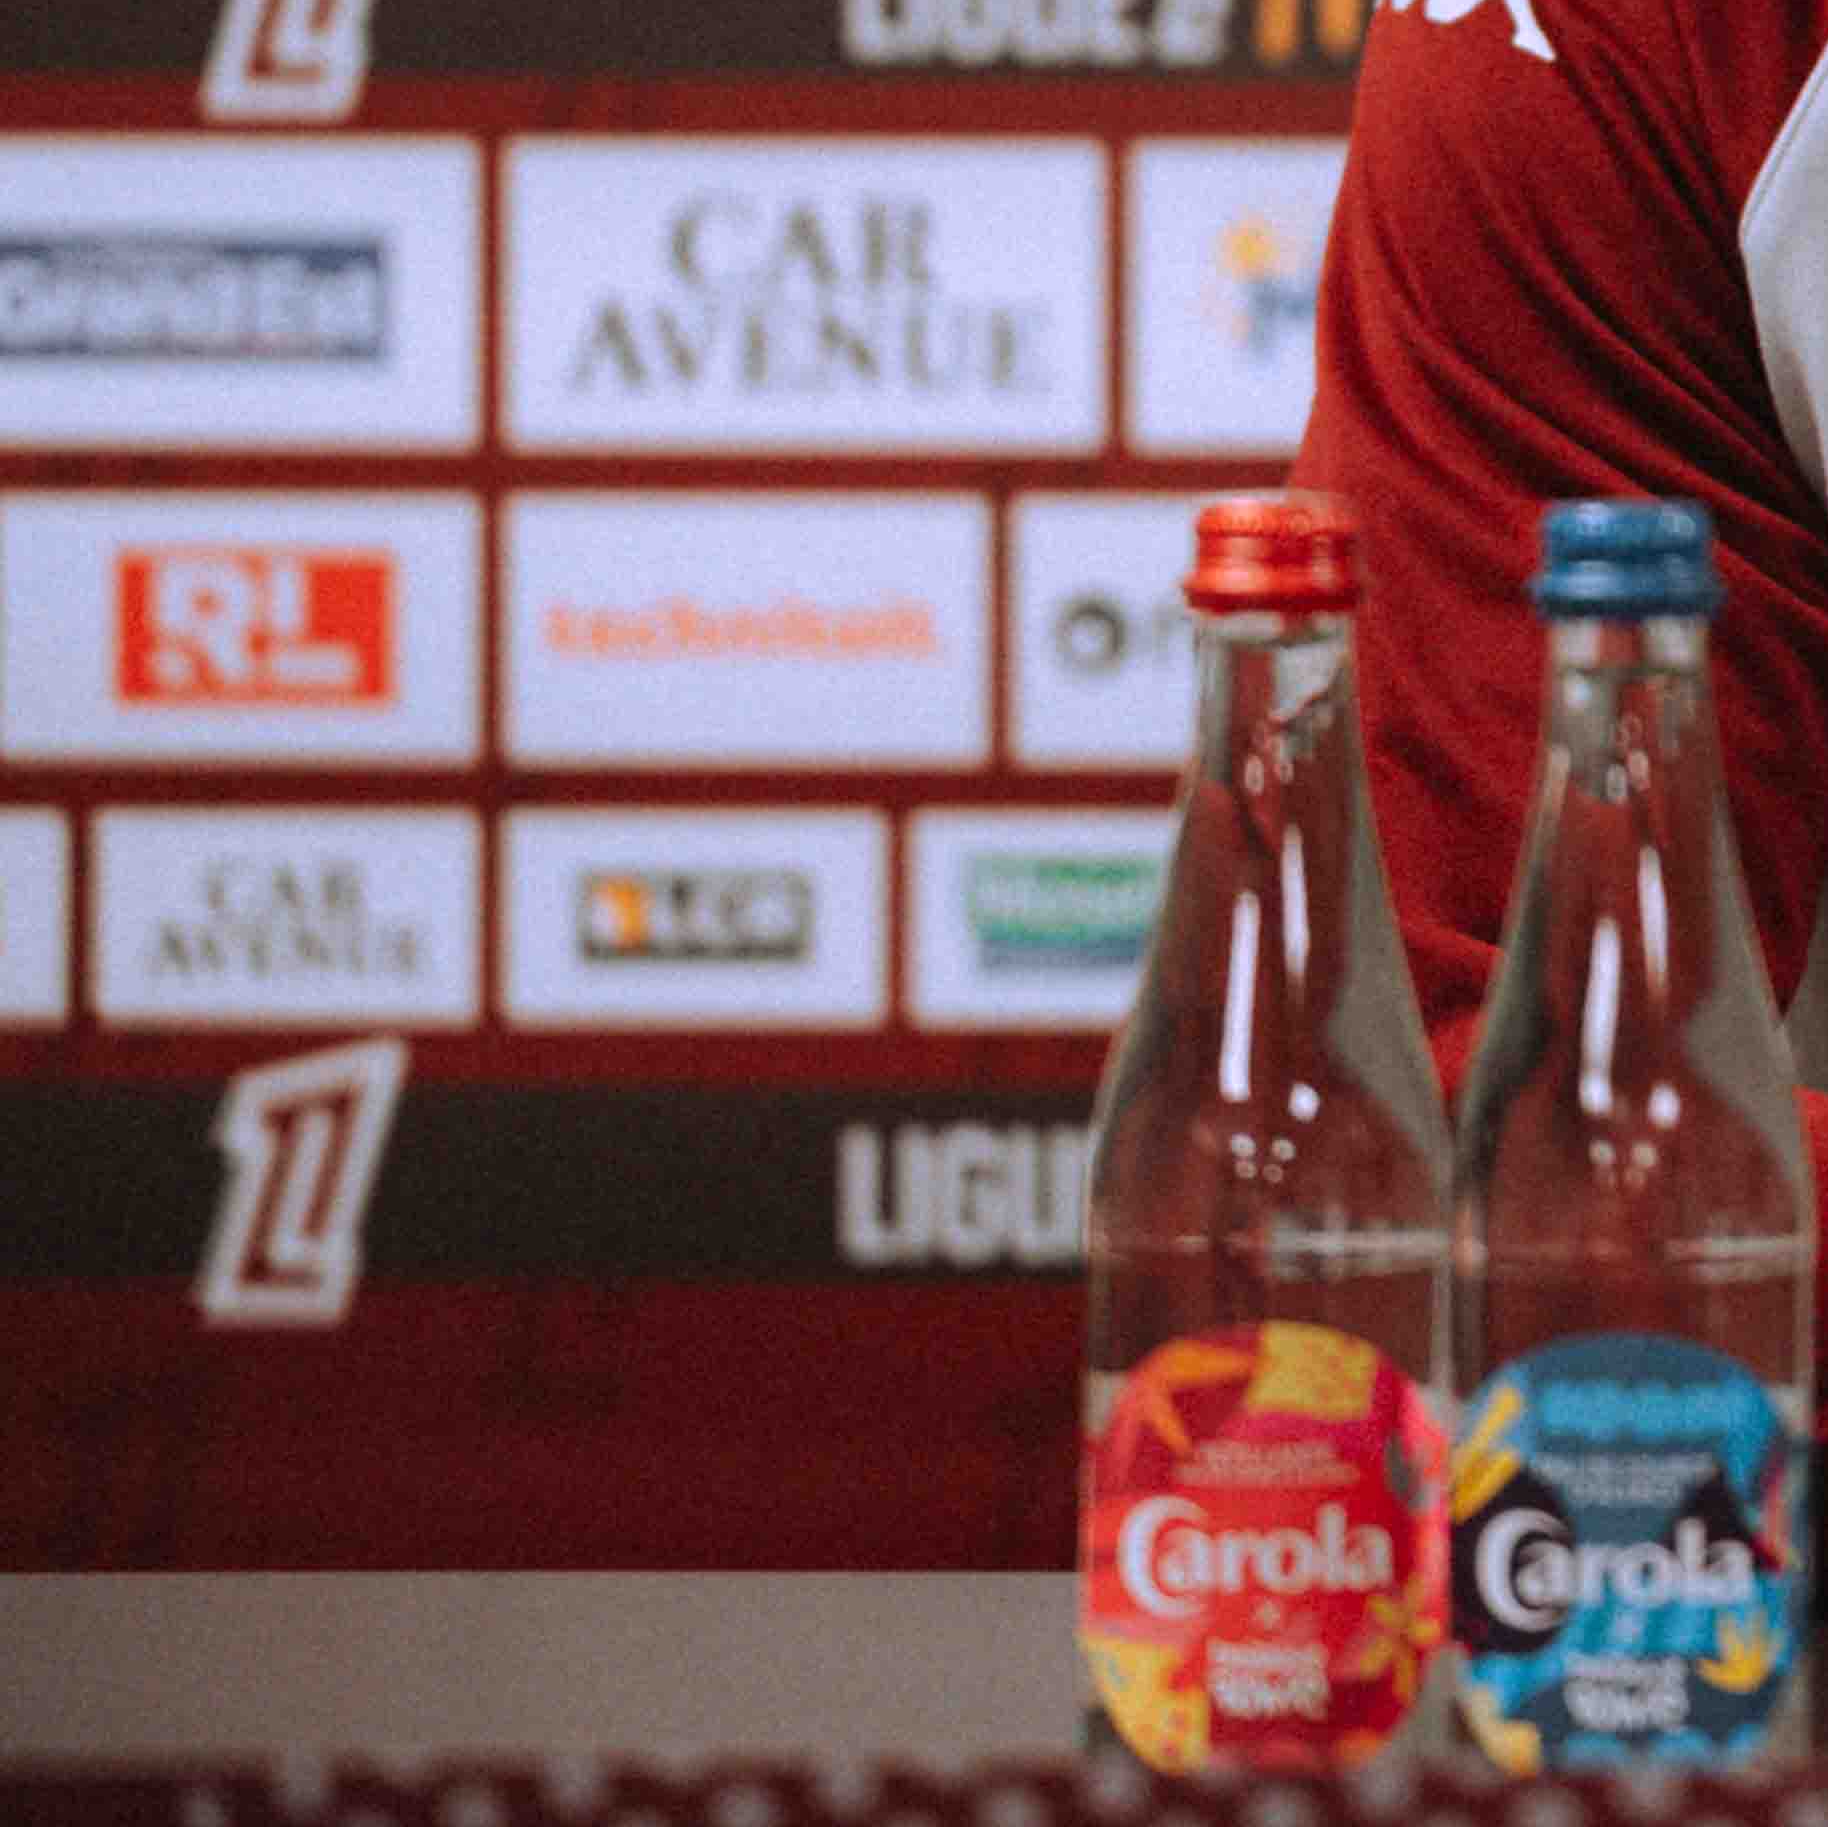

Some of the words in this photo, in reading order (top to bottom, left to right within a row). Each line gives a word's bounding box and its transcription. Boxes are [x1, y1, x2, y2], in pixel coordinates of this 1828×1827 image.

[668, 192, 940, 292] CAR
[570, 298, 1056, 396] AVENUE
[154, 560, 360, 686] RL
[834, 1120, 1093, 1267] LIGU
[1117, 1494, 1393, 1620] Carola
[1475, 1507, 1755, 1634] Carola
